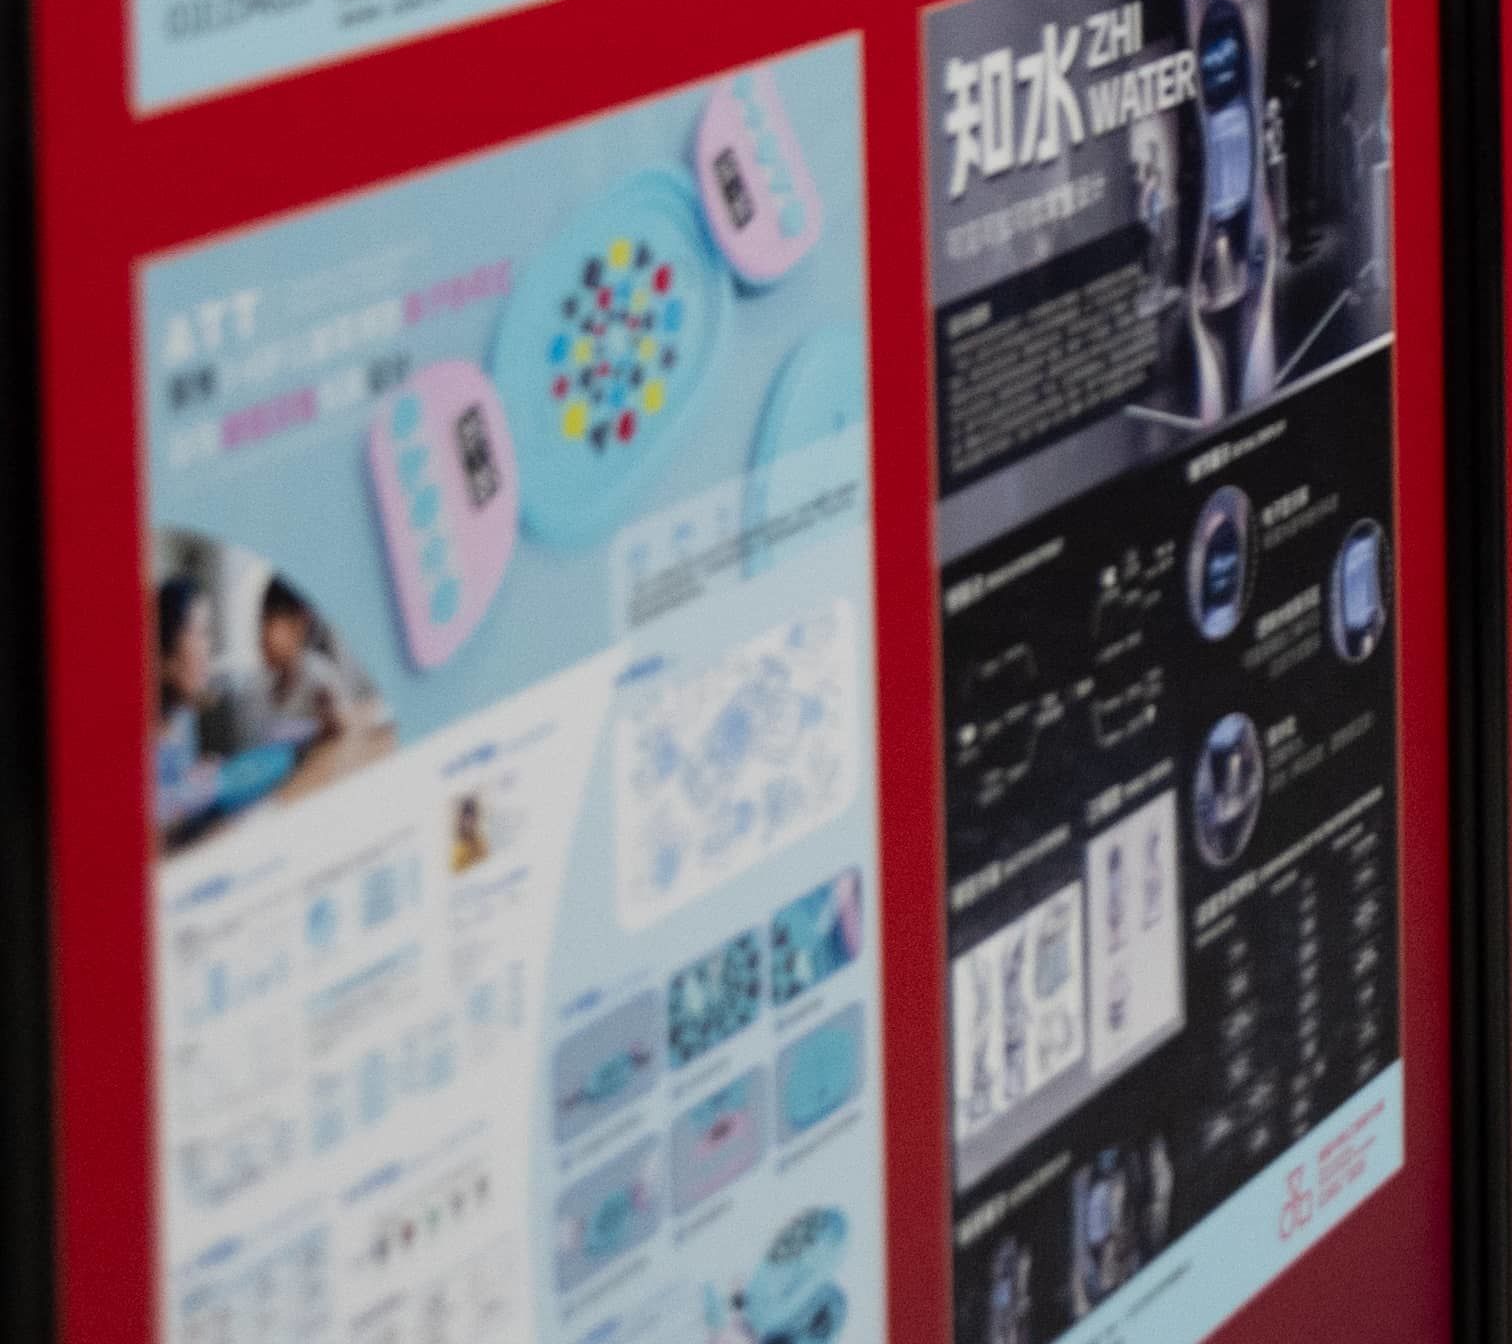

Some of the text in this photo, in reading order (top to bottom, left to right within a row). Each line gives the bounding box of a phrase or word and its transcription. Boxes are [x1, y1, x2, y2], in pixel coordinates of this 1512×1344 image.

[944, 0, 1143, 202] 知水 ZHI
[1085, 48, 1195, 138] WATER
